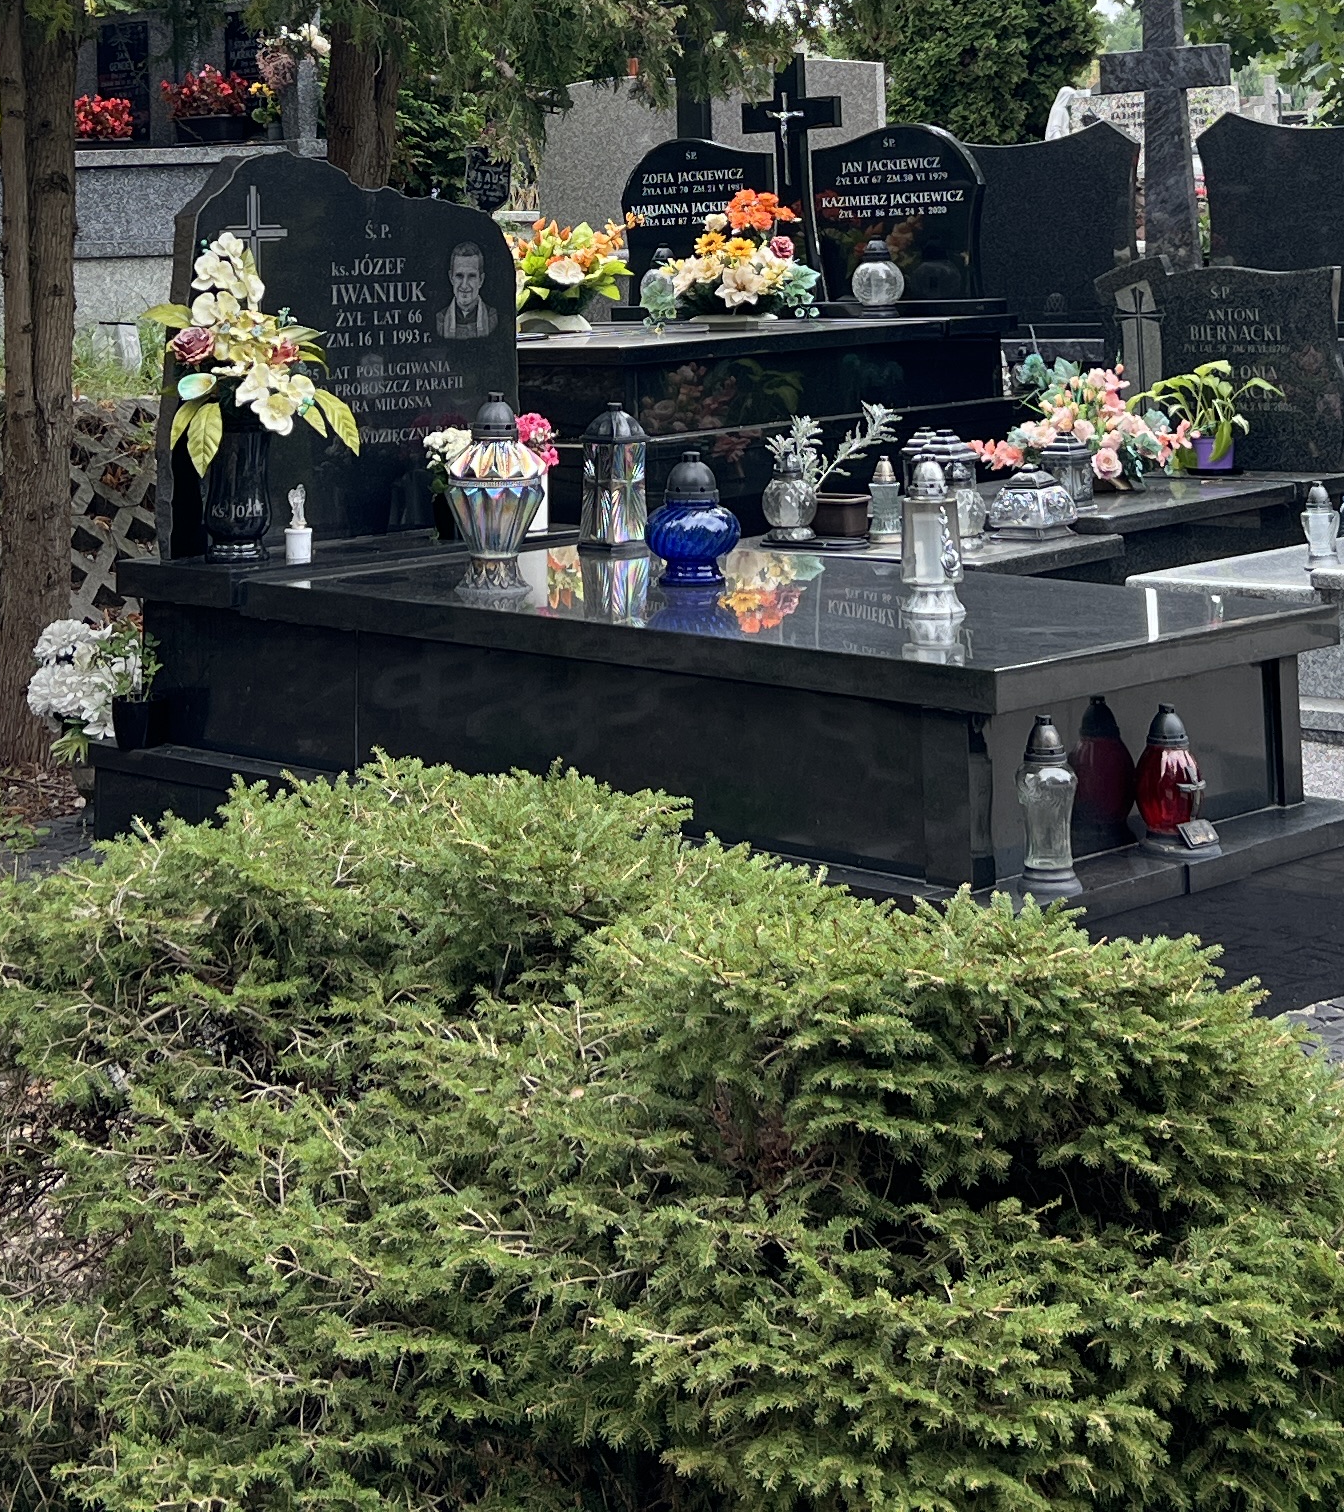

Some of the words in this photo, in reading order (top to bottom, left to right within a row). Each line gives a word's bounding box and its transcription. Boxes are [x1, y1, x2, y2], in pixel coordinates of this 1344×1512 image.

[841, 160, 863, 175] JAN
[867, 156, 942, 173] JACKIEWICZ
[641, 172, 675, 185] ZOFIA
[677, 168, 744, 185] JACKIEWICZ
[854, 175, 870, 185] LAT
[663, 186, 678, 195] LAT
[821, 193, 888, 208] KAZIMIERZ
[890, 190, 965, 207] JACKIEWICZ
[630, 202, 689, 217] MARIANNA
[691, 201, 729, 215] JACKIE
[857, 208, 872, 218] LAT
[330, 261, 349, 277] ks.
[351, 253, 407, 276] JÓZEF
[331, 281, 427, 305] IWANIUK
[373, 309, 402, 326] LAT
[407, 308, 423, 324] 66
[1206, 307, 1261, 322] ANTONI
[325, 332, 354, 349] ZM.
[358, 331, 373, 347] 16
[378, 330, 385, 346] I
[392, 328, 420, 345] 1993
[1190, 324, 1283, 342] BIERNACKI
[335, 379, 411, 398] PROBOSZCZ
[415, 375, 464, 392] PARAFII
[374, 394, 433, 412] MIŁOSNA
